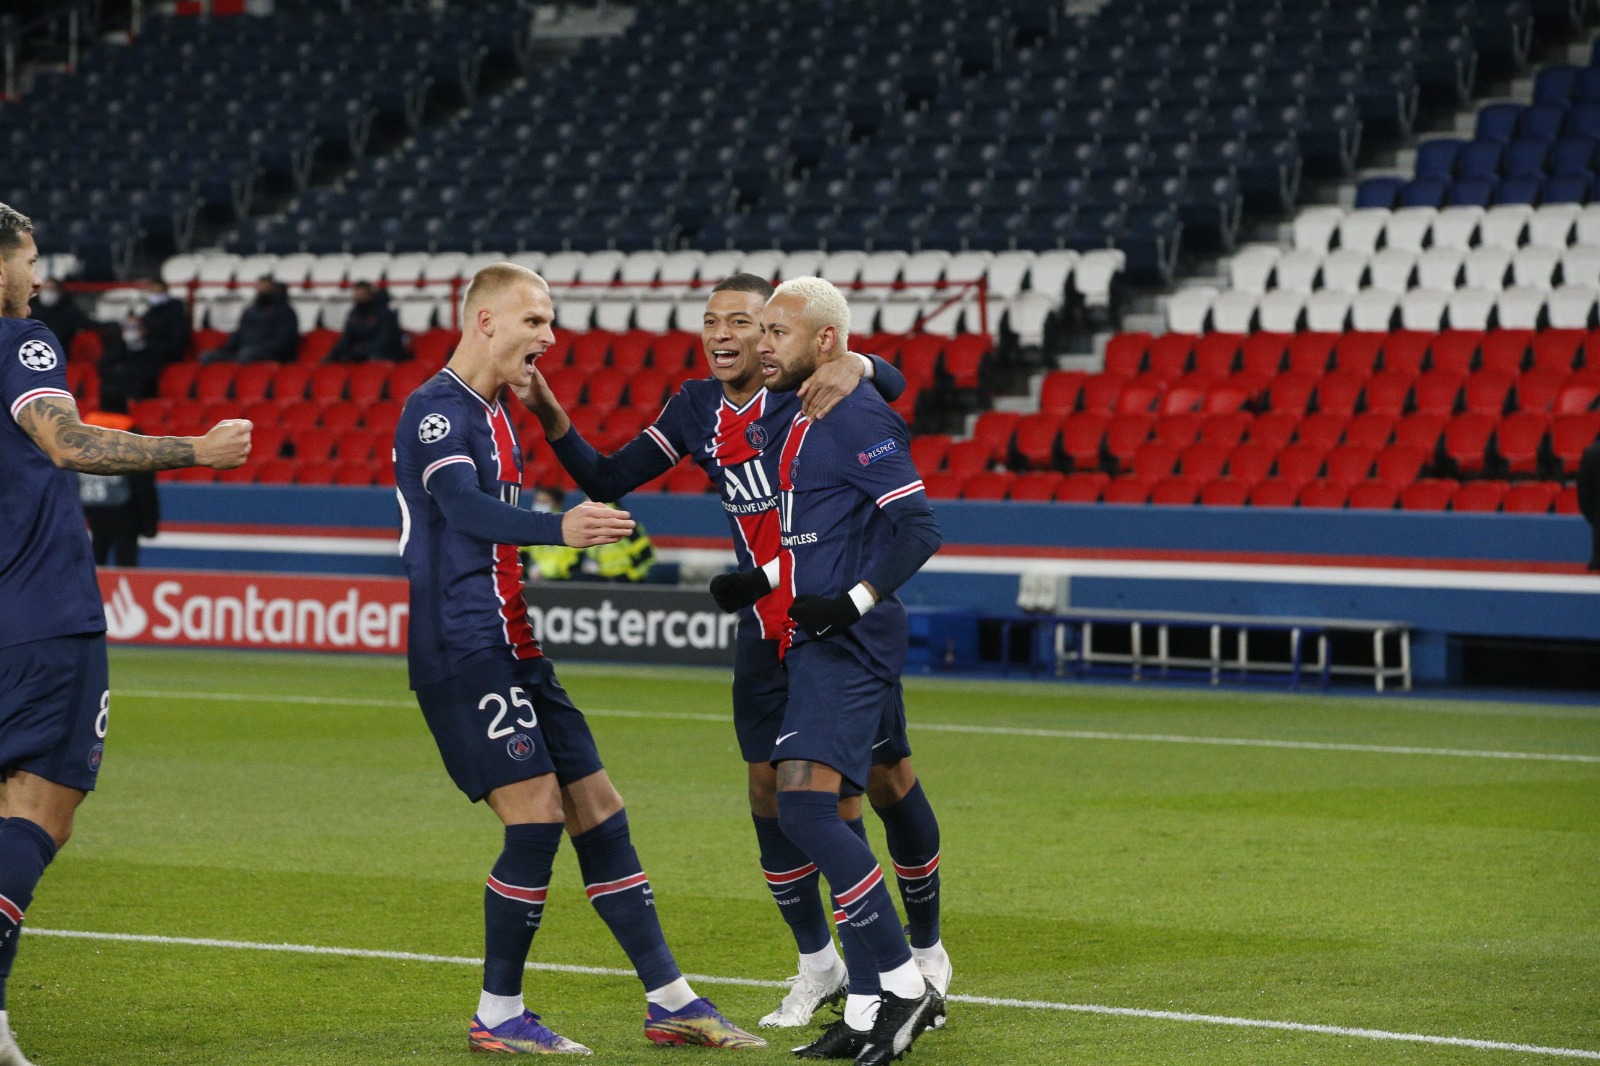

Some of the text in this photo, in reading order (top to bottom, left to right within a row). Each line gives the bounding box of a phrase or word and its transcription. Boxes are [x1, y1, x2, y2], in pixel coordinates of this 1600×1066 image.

[867, 441, 897, 459] RESPECT
[739, 503, 757, 514] LIVE
[151, 580, 407, 649] Santander
[527, 600, 740, 649] astercar
[95, 689, 110, 739] 8
[478, 686, 538, 740] 25
[774, 896, 801, 906] PARIS
[906, 890, 937, 904] PARIS
[850, 911, 880, 929] PARIS
